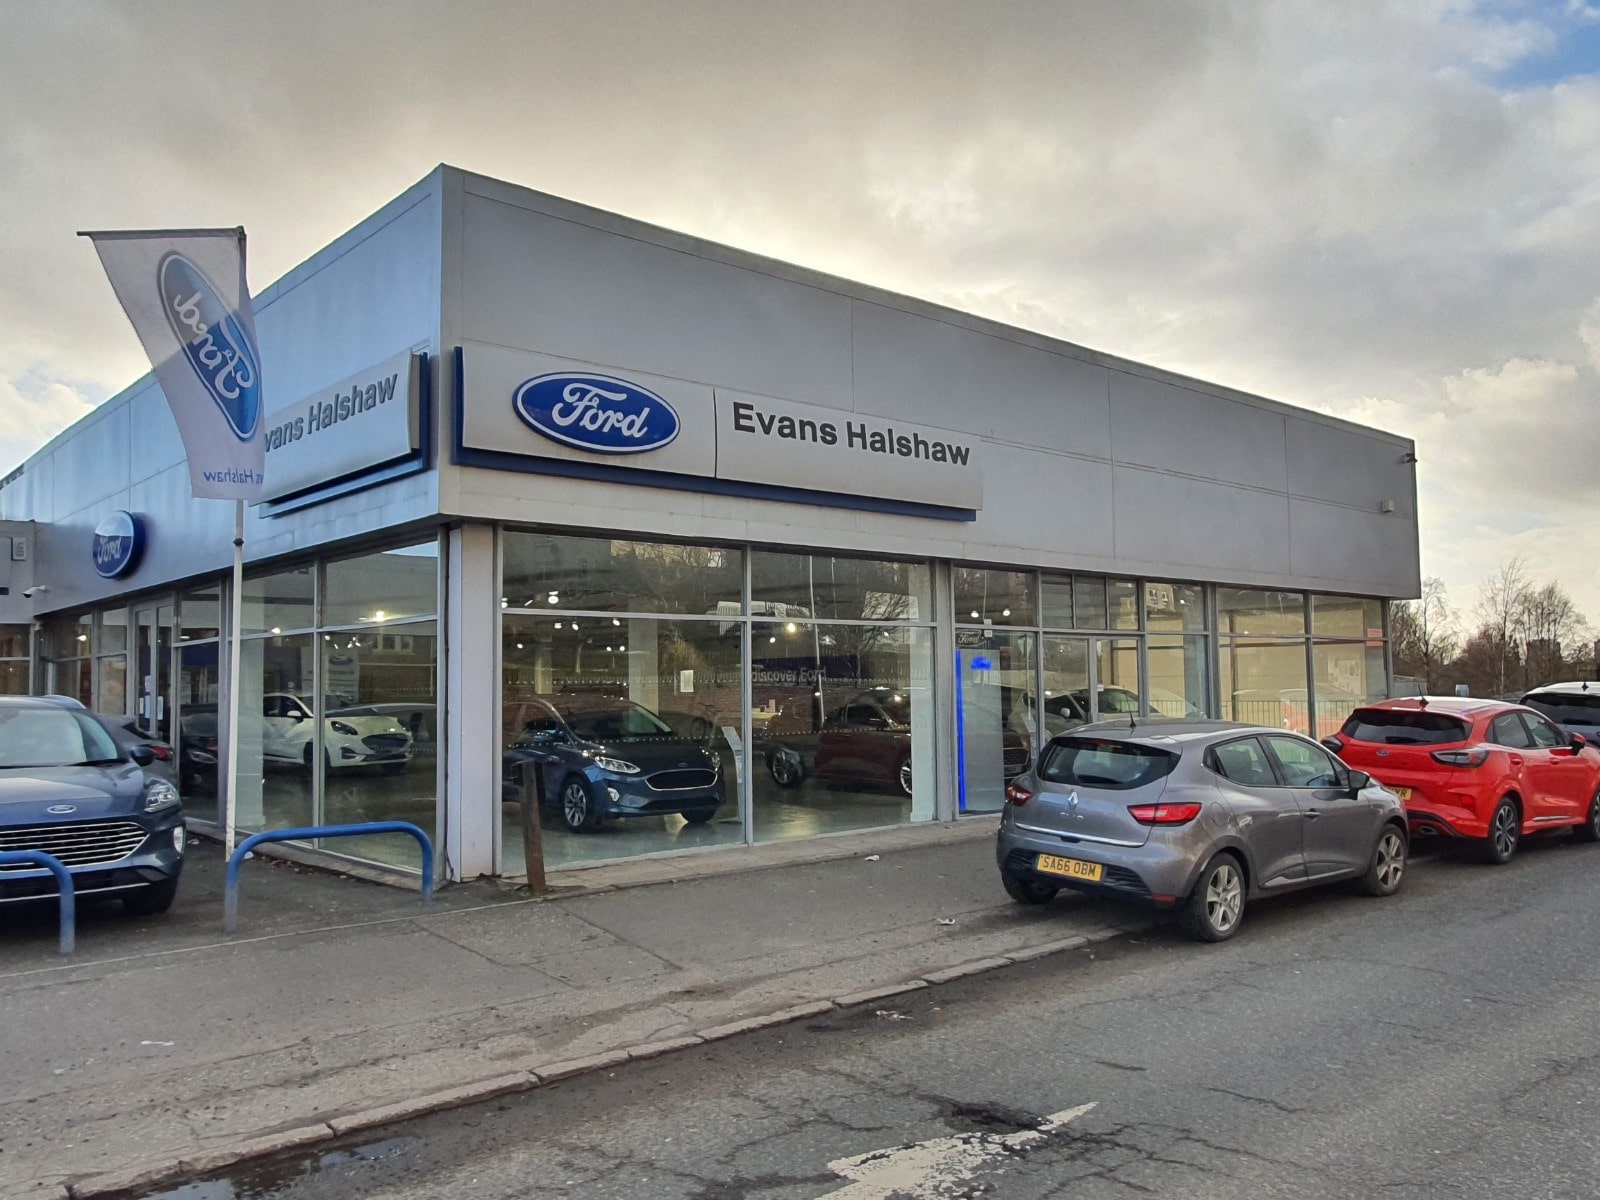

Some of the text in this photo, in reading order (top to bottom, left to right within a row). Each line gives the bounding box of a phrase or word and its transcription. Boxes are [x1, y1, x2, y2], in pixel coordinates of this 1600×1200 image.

[264, 373, 398, 453] vans Halshaw
[552, 383, 651, 438] Ford
[733, 401, 970, 466] Evans Halshaw
[1043, 856, 1071, 872] SA66
